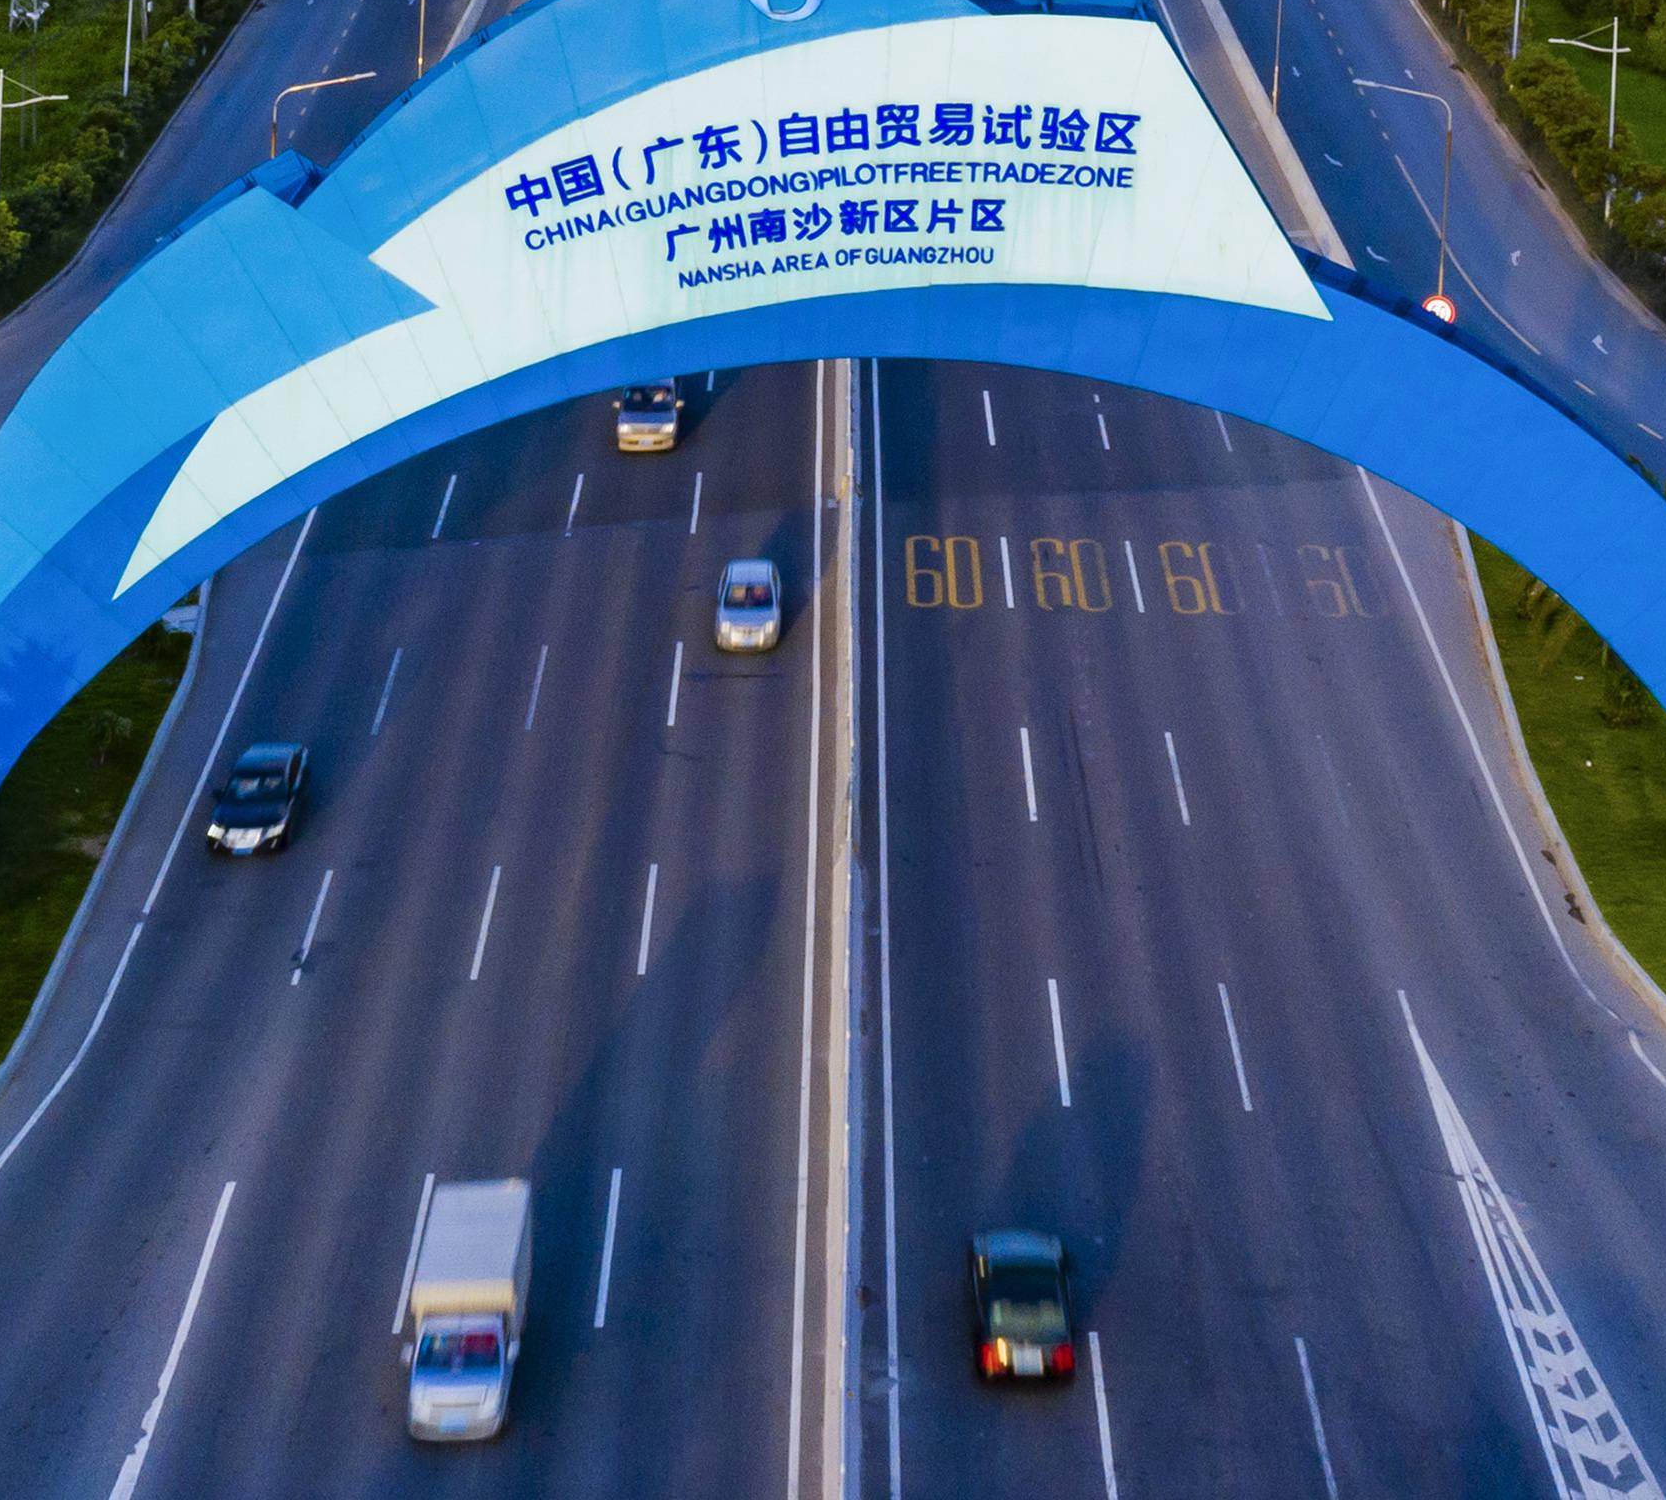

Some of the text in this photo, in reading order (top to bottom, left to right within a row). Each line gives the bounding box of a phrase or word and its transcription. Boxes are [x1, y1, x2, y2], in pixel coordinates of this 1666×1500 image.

[665, 198, 1007, 262] 广州南沙新区片区
[678, 260, 766, 289] NANSHA
[771, 251, 830, 274] AREA
[905, 536, 983, 609] 60
[1030, 538, 1113, 612] 60
